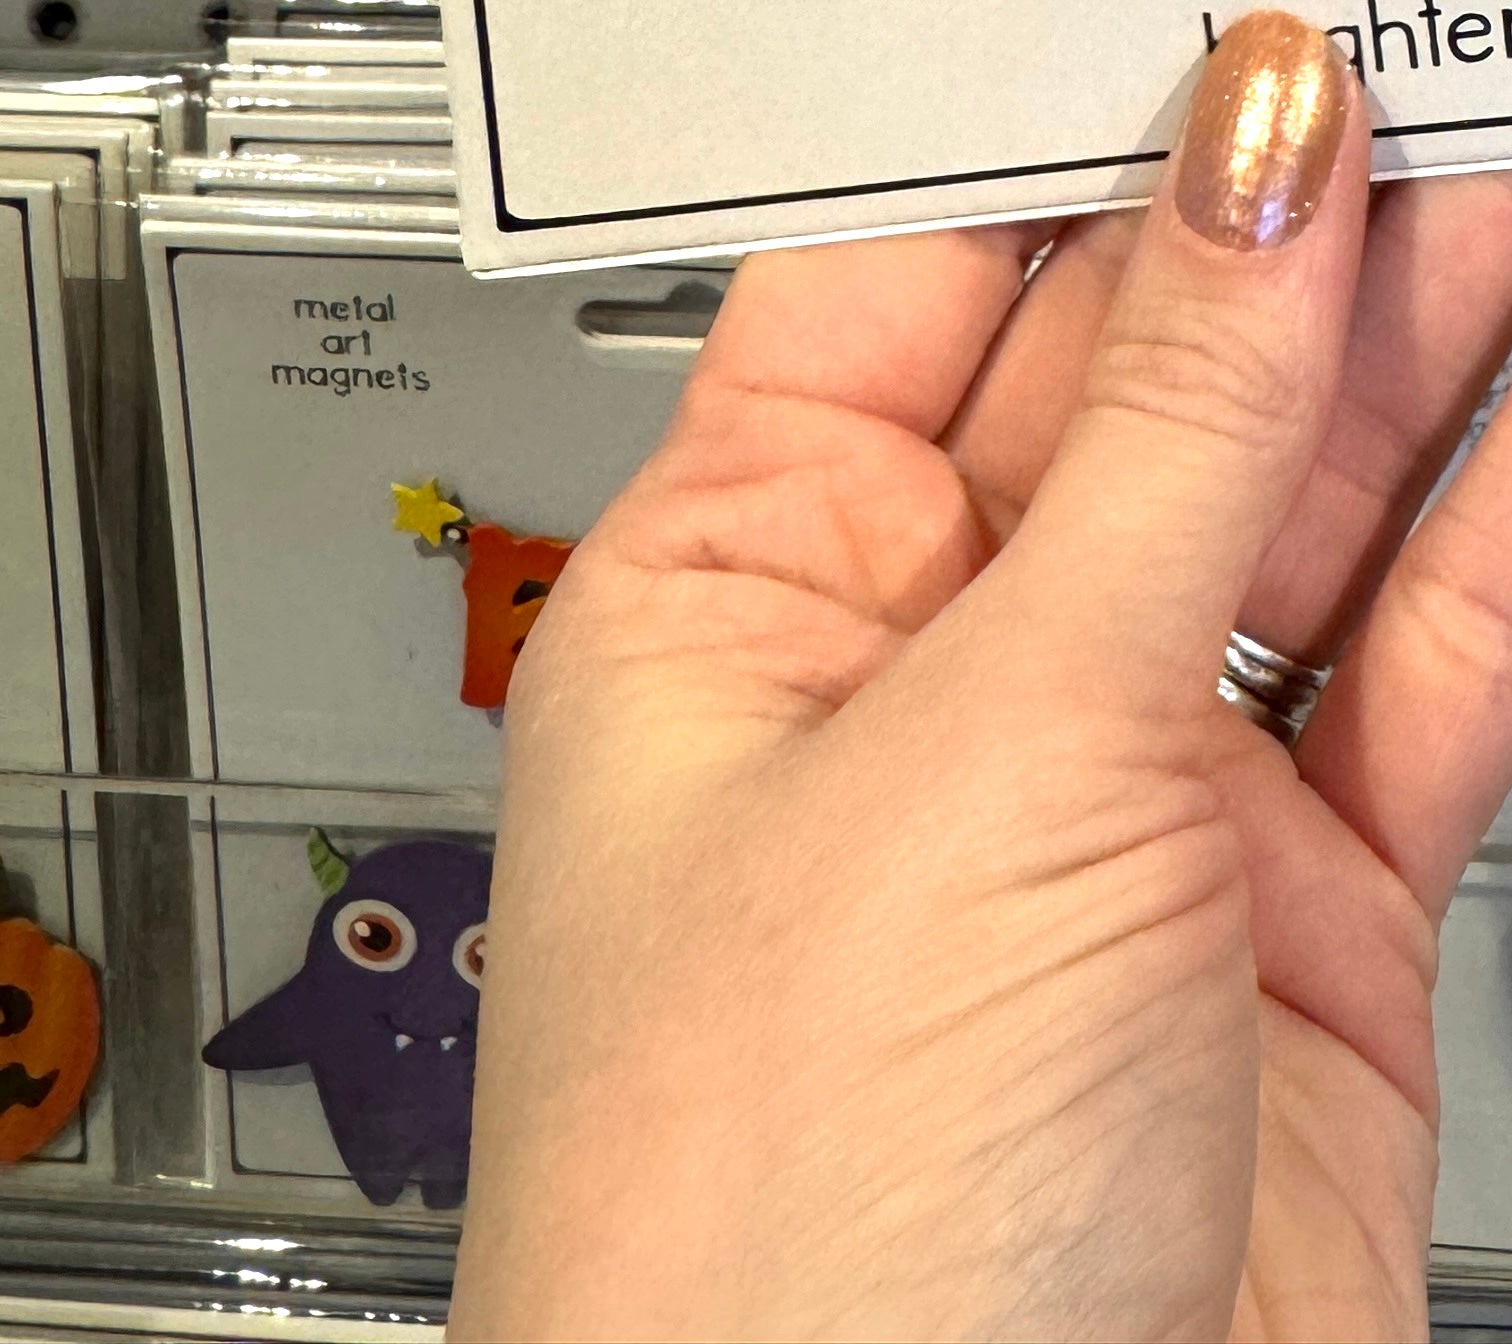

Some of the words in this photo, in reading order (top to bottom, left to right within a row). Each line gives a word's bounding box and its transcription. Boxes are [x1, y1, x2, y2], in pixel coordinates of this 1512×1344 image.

[293, 293, 397, 322] metal
[320, 329, 371, 356] art
[271, 362, 431, 397] magnets
